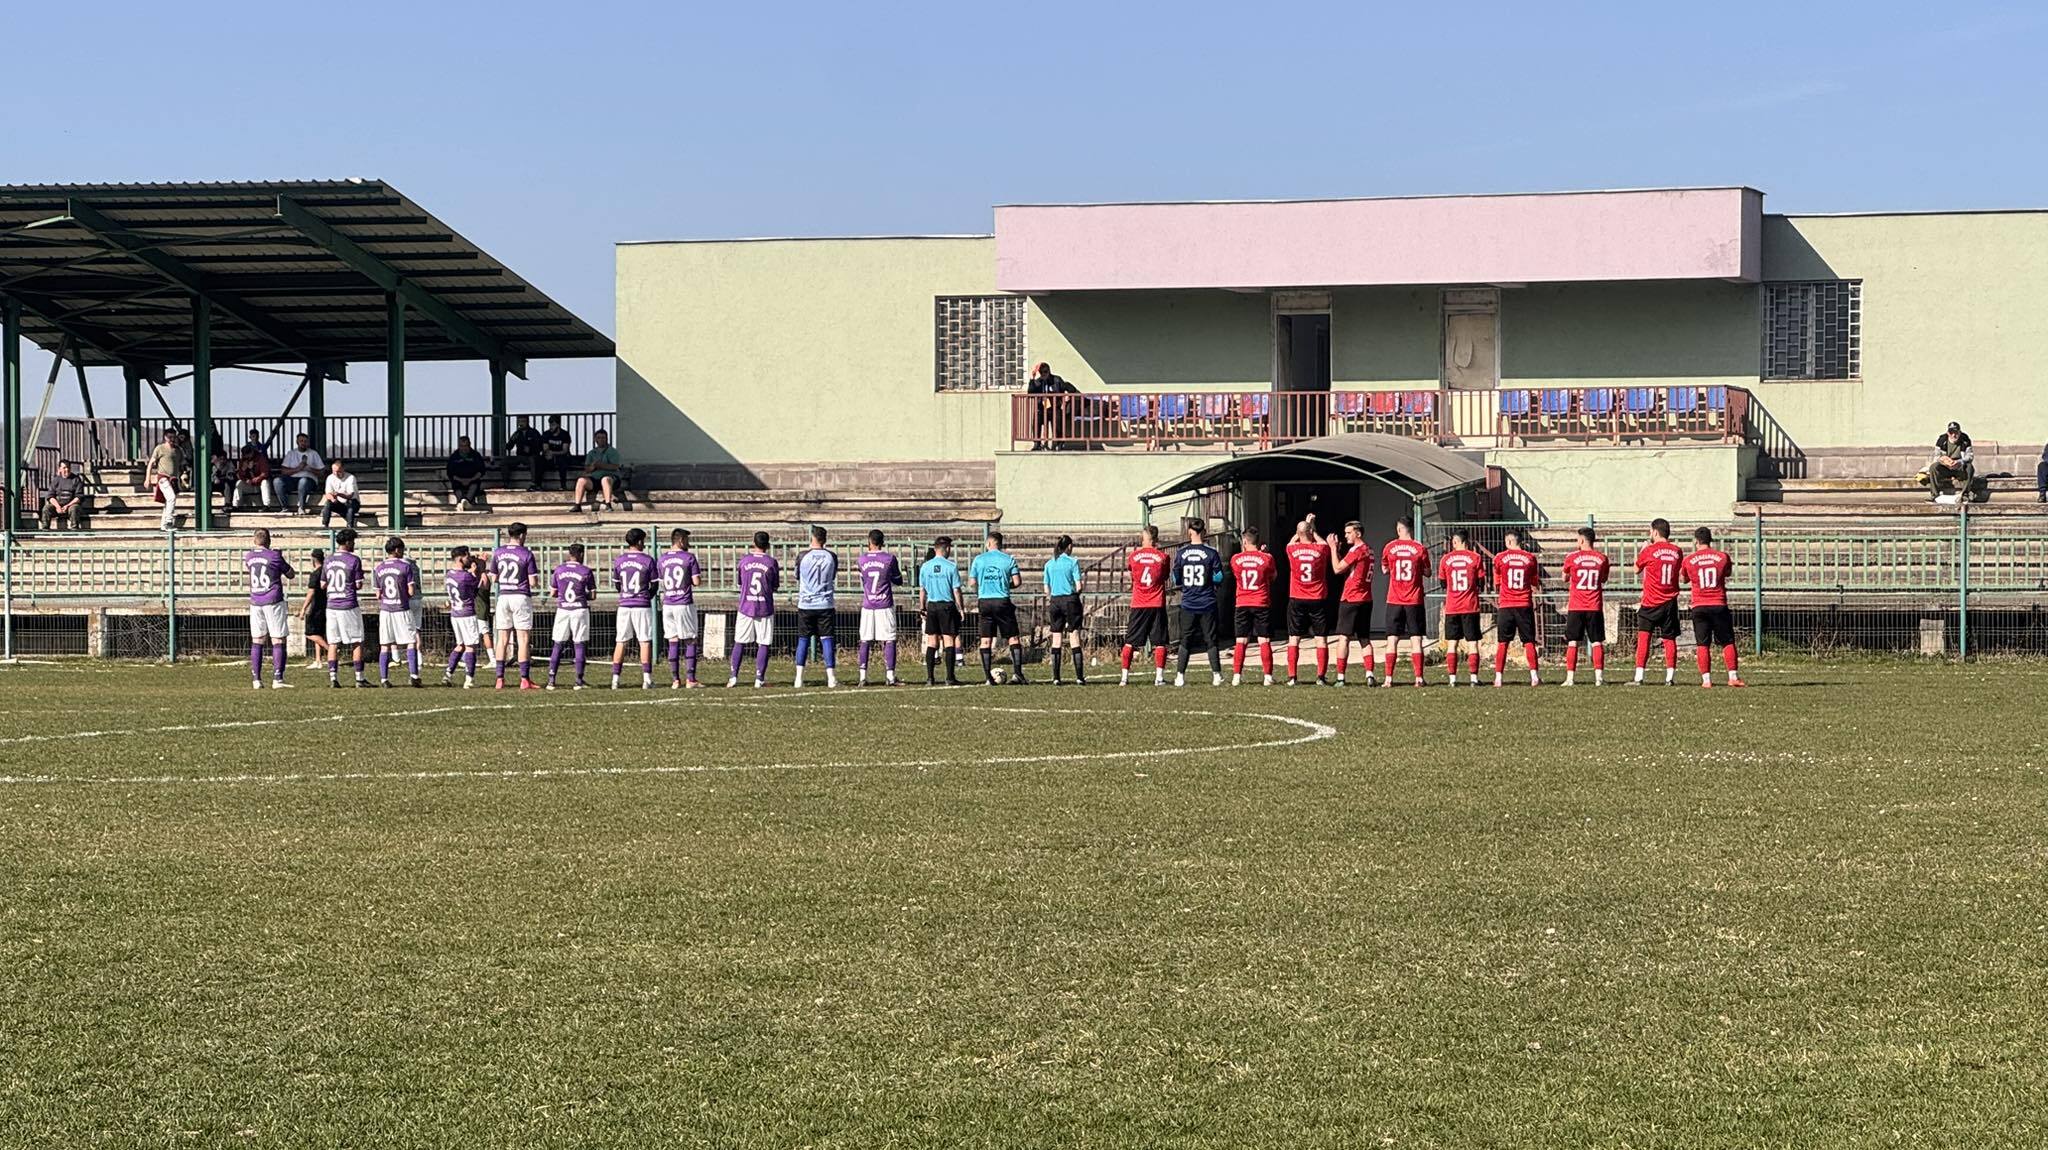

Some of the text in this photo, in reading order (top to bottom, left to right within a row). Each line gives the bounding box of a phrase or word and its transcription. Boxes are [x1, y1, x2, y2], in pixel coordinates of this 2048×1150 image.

[326, 569, 346, 592] 20
[498, 560, 519, 584] 22
[663, 565, 684, 590] 69
[1140, 566, 1152, 587] 4
[1183, 565, 1205, 587] 93
[1241, 569, 1259, 591] 12
[1300, 563, 1312, 582] 3
[1395, 559, 1412, 581] 13
[1451, 569, 1468, 592] 15
[1507, 568, 1524, 590] 19
[1576, 569, 1599, 590] 20
[1661, 563, 1672, 585] 11
[1698, 567, 1717, 589] 10
[384, 575, 397, 599] 8
[564, 581, 576, 603] 6
[619, 570, 641, 594] 14
[749, 572, 762, 595] 5
[868, 571, 880, 594] 7
